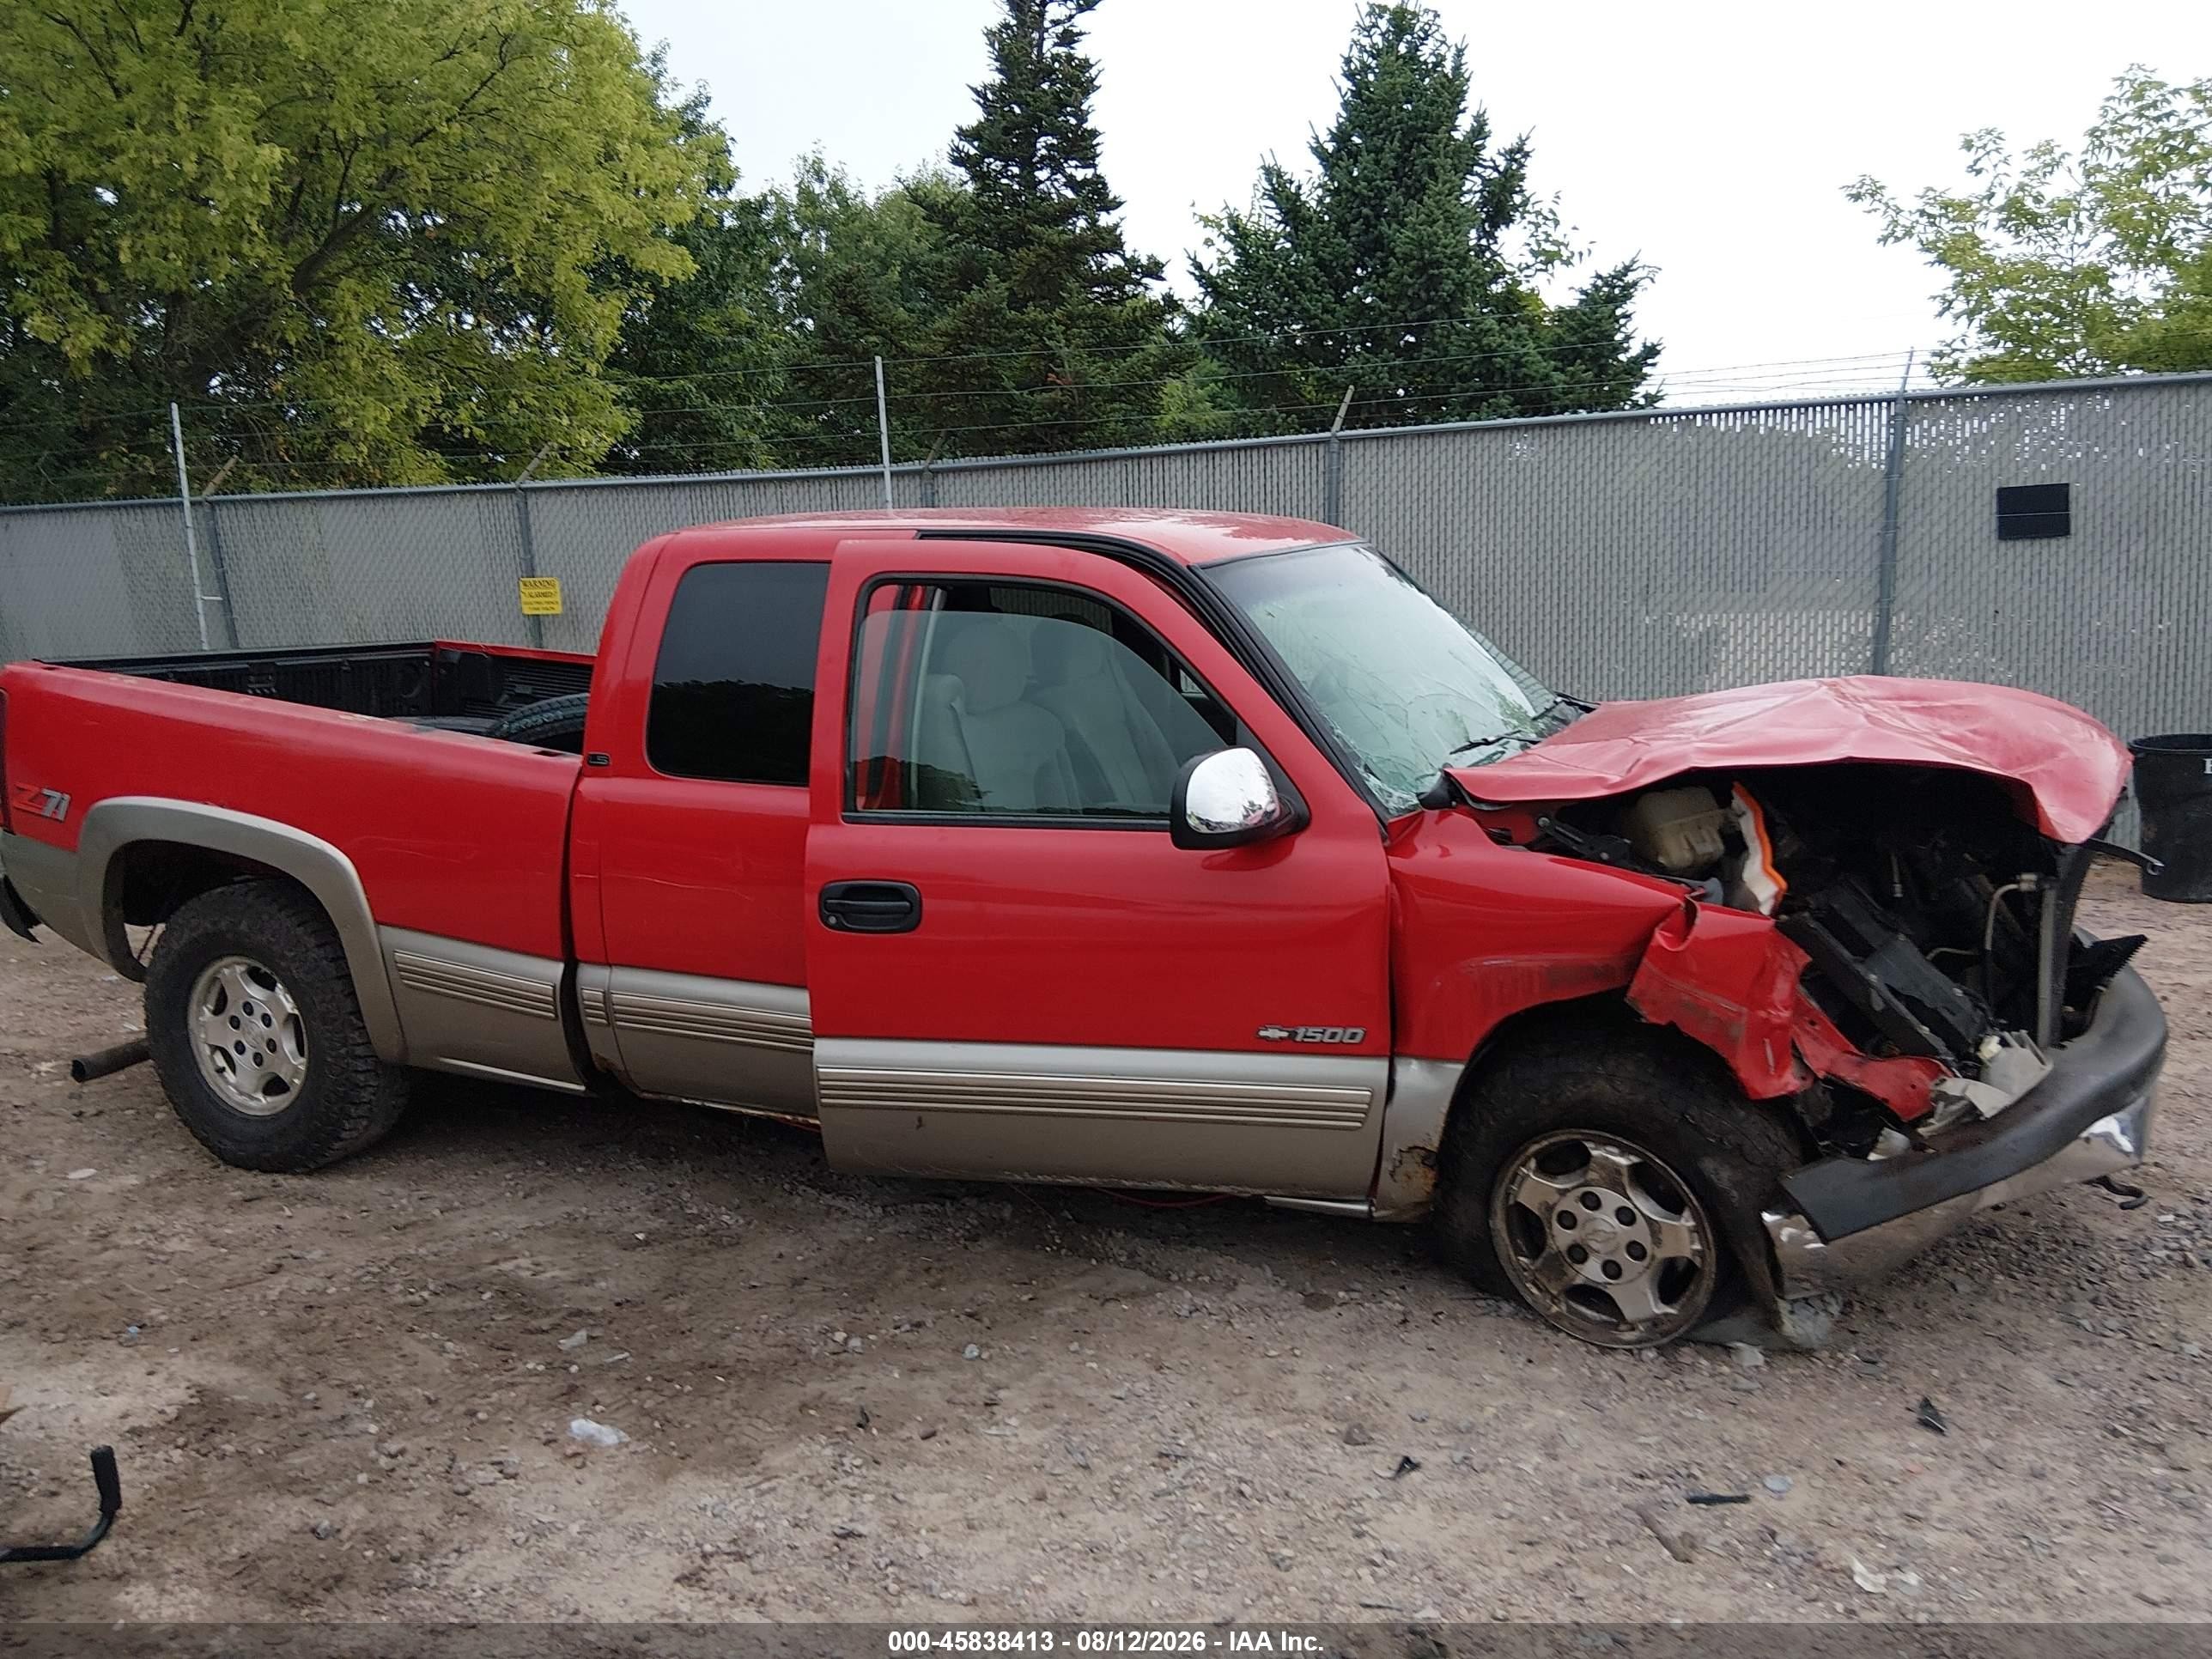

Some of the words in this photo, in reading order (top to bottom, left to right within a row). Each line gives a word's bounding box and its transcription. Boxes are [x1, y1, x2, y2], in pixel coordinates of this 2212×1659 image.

[522, 580, 556, 588] WARNING
[13, 782, 71, 822] Z71
[1294, 1027, 1365, 1043] 1500
